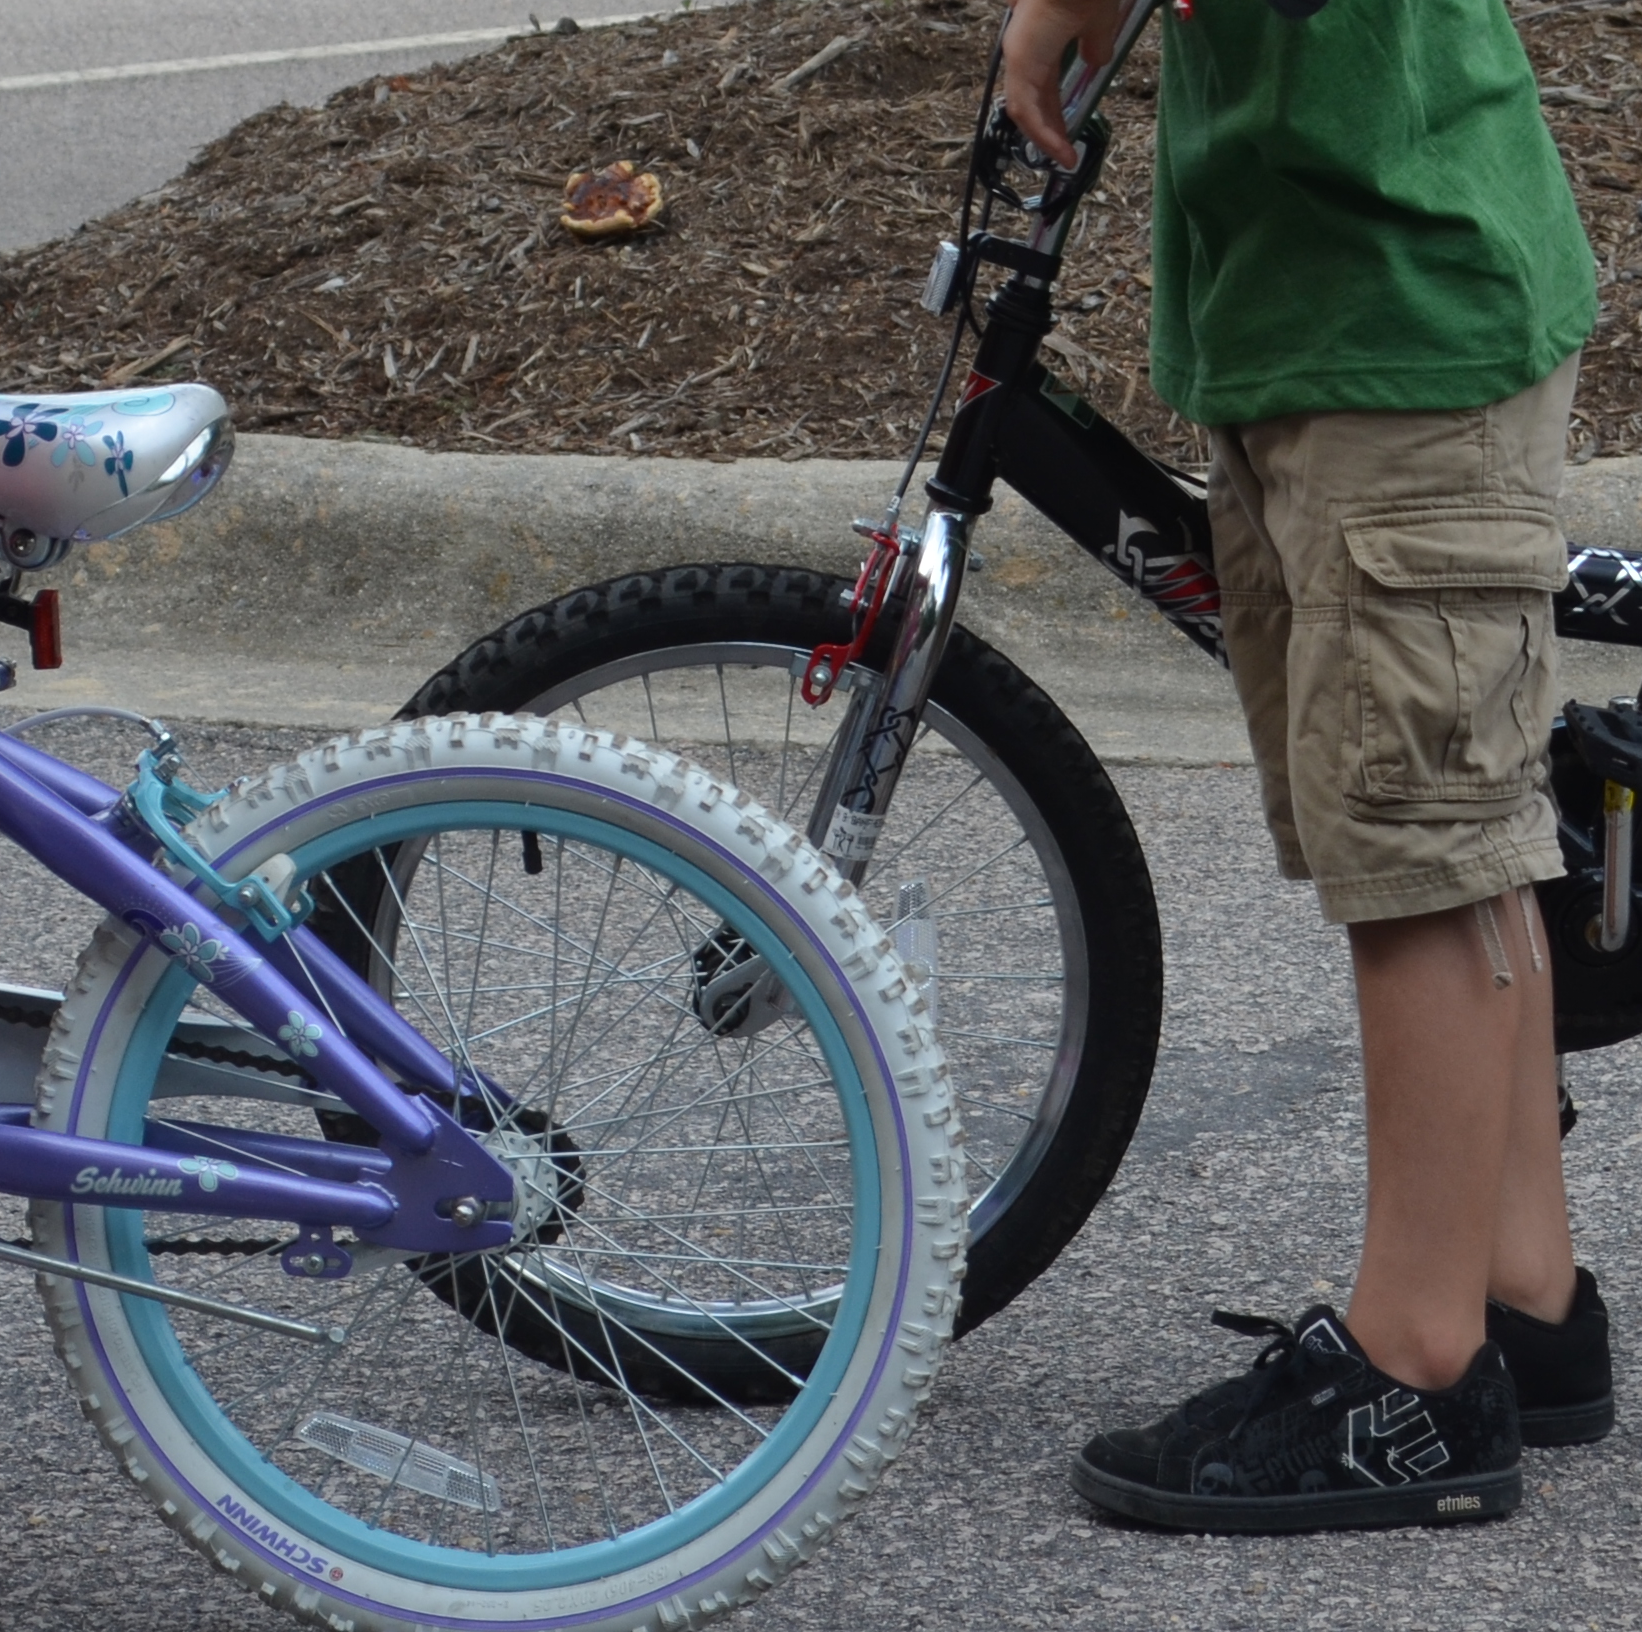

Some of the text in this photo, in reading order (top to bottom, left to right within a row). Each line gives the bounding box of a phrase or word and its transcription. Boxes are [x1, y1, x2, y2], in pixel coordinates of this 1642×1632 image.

[70, 1165, 183, 1197] Schwinn
[1437, 1494, 1481, 1512] etnies
[216, 1494, 329, 1574] SCHWINN
